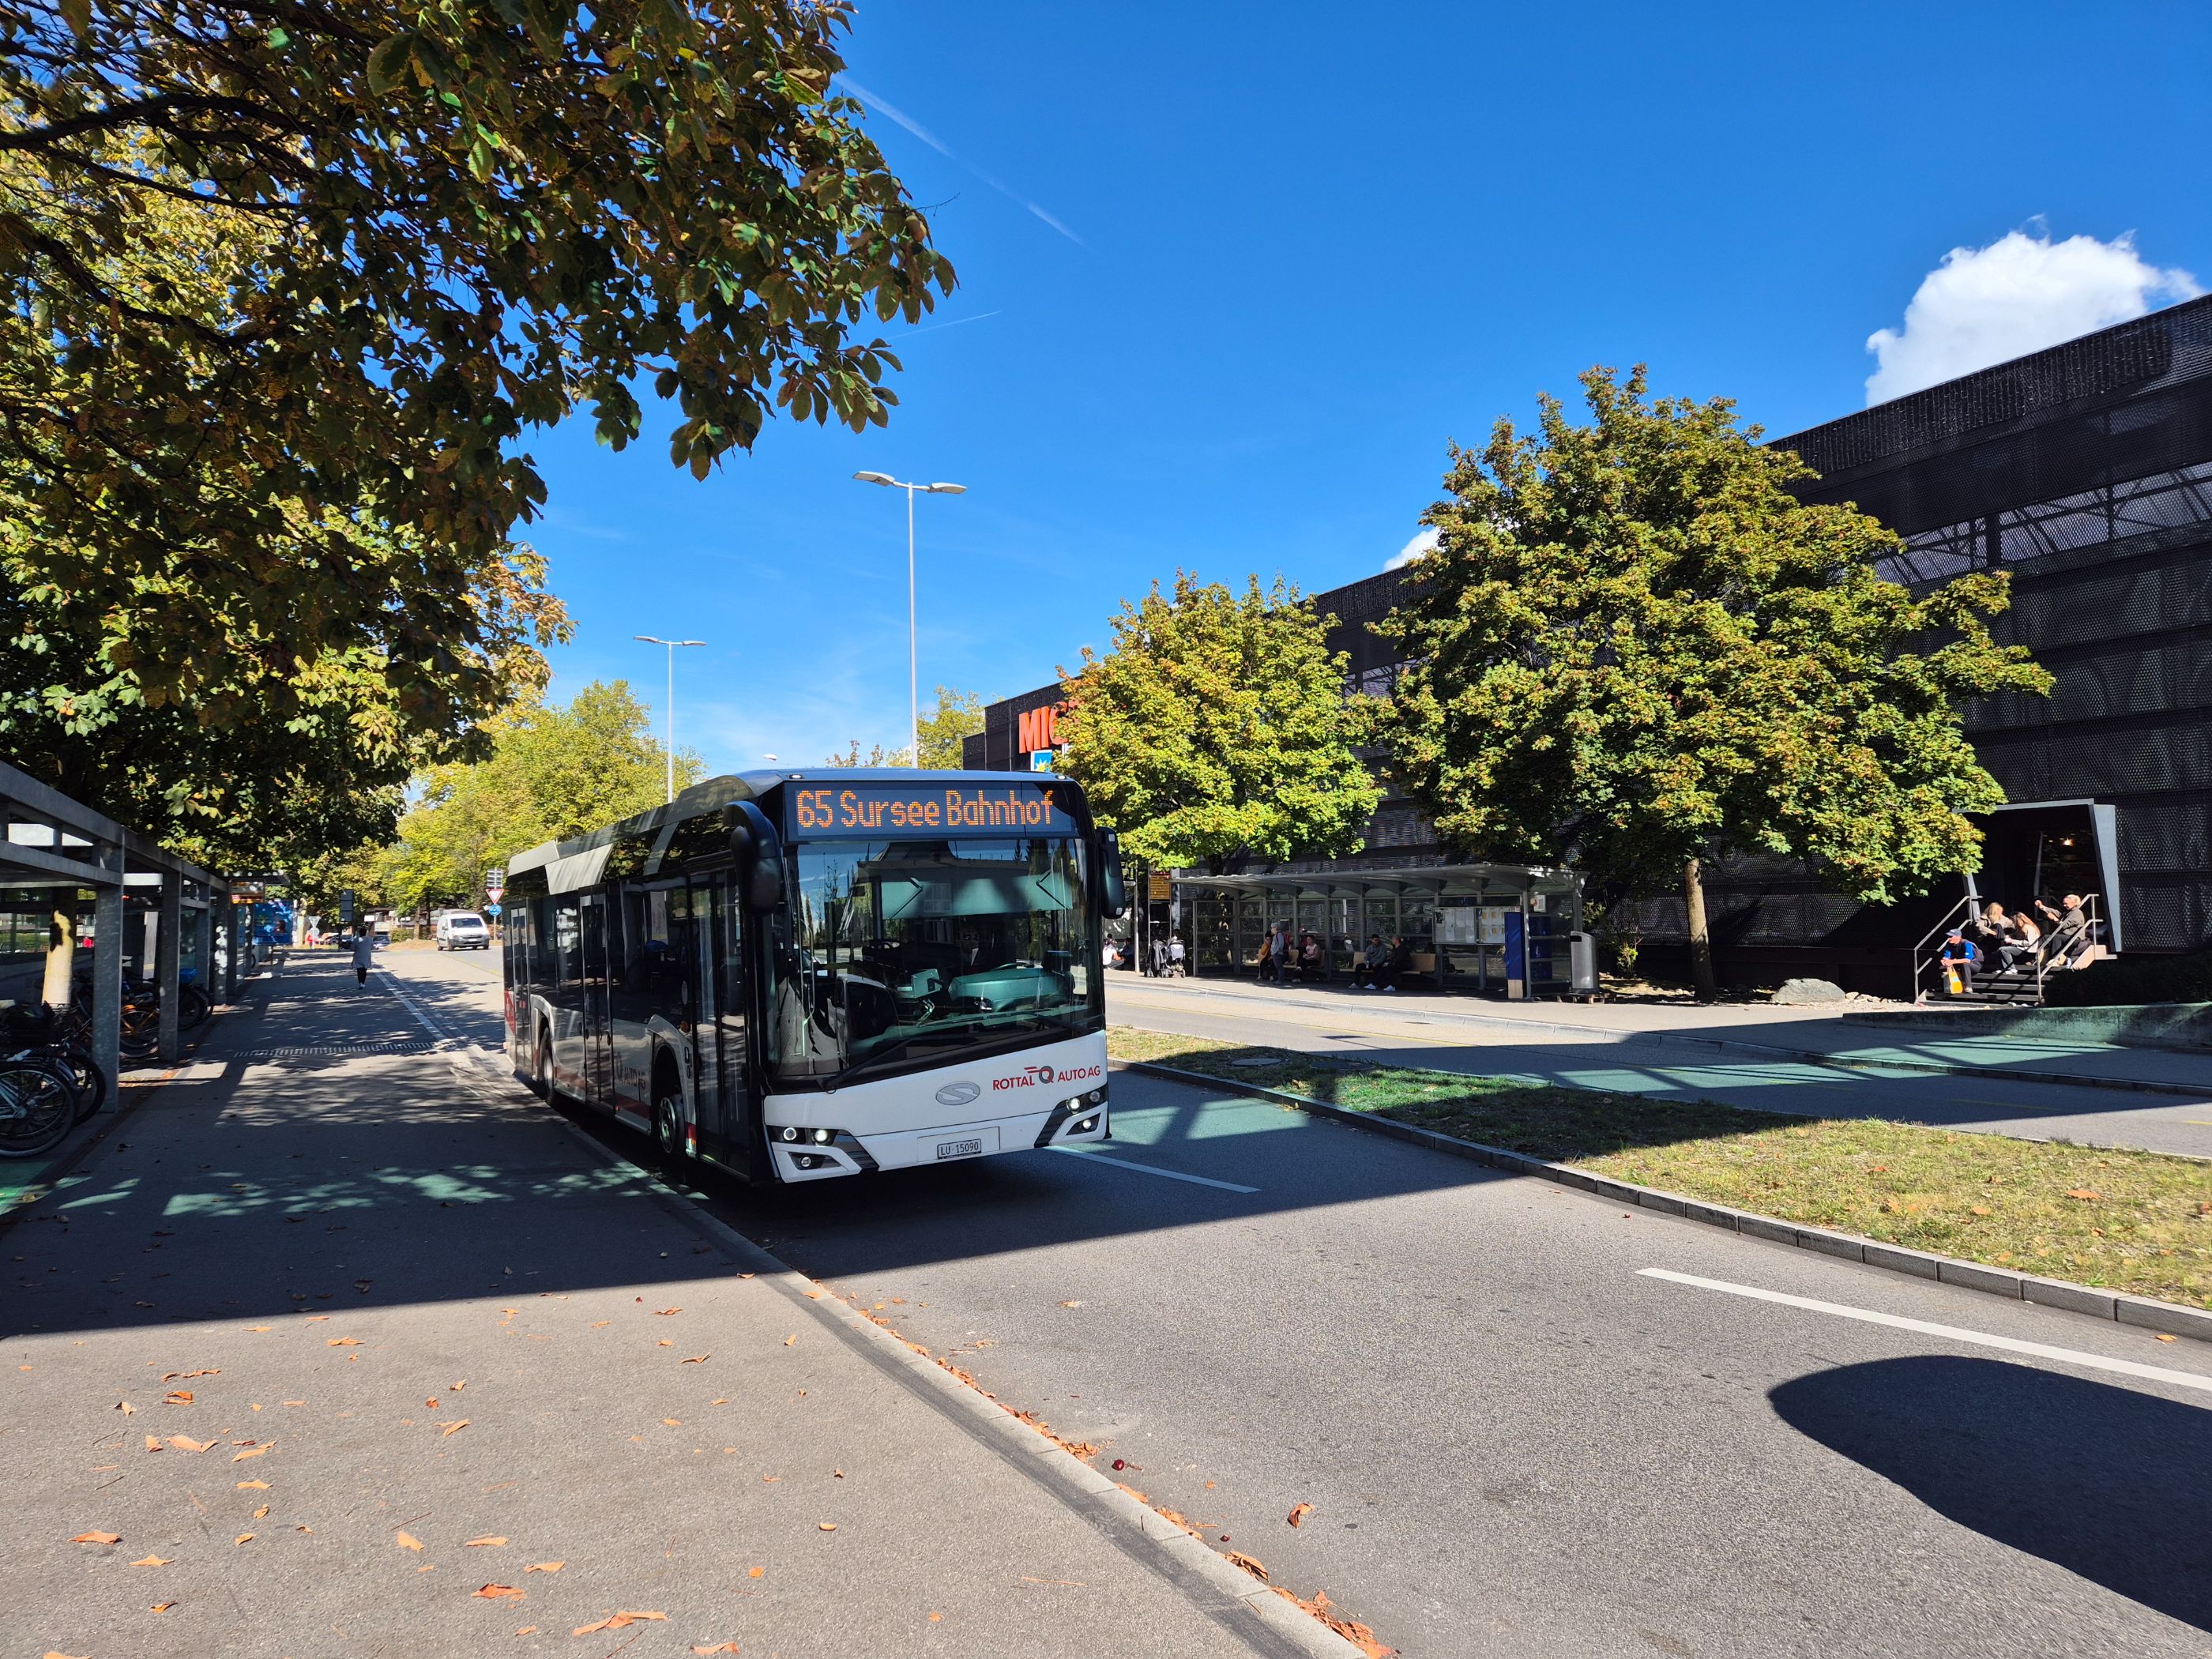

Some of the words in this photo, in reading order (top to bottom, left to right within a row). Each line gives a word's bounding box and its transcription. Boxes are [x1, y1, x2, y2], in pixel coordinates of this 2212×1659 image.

[797, 790, 833, 827] 65
[840, 790, 940, 827] Sursee
[946, 790, 1053, 826] Bahnhof
[992, 1075, 1035, 1091] ROTTAL
[1057, 1068, 1086, 1082] AUTO
[1087, 1065, 1101, 1078] AG
[940, 1146, 950, 1155] LU
[956, 1142, 979, 1153] 15090
